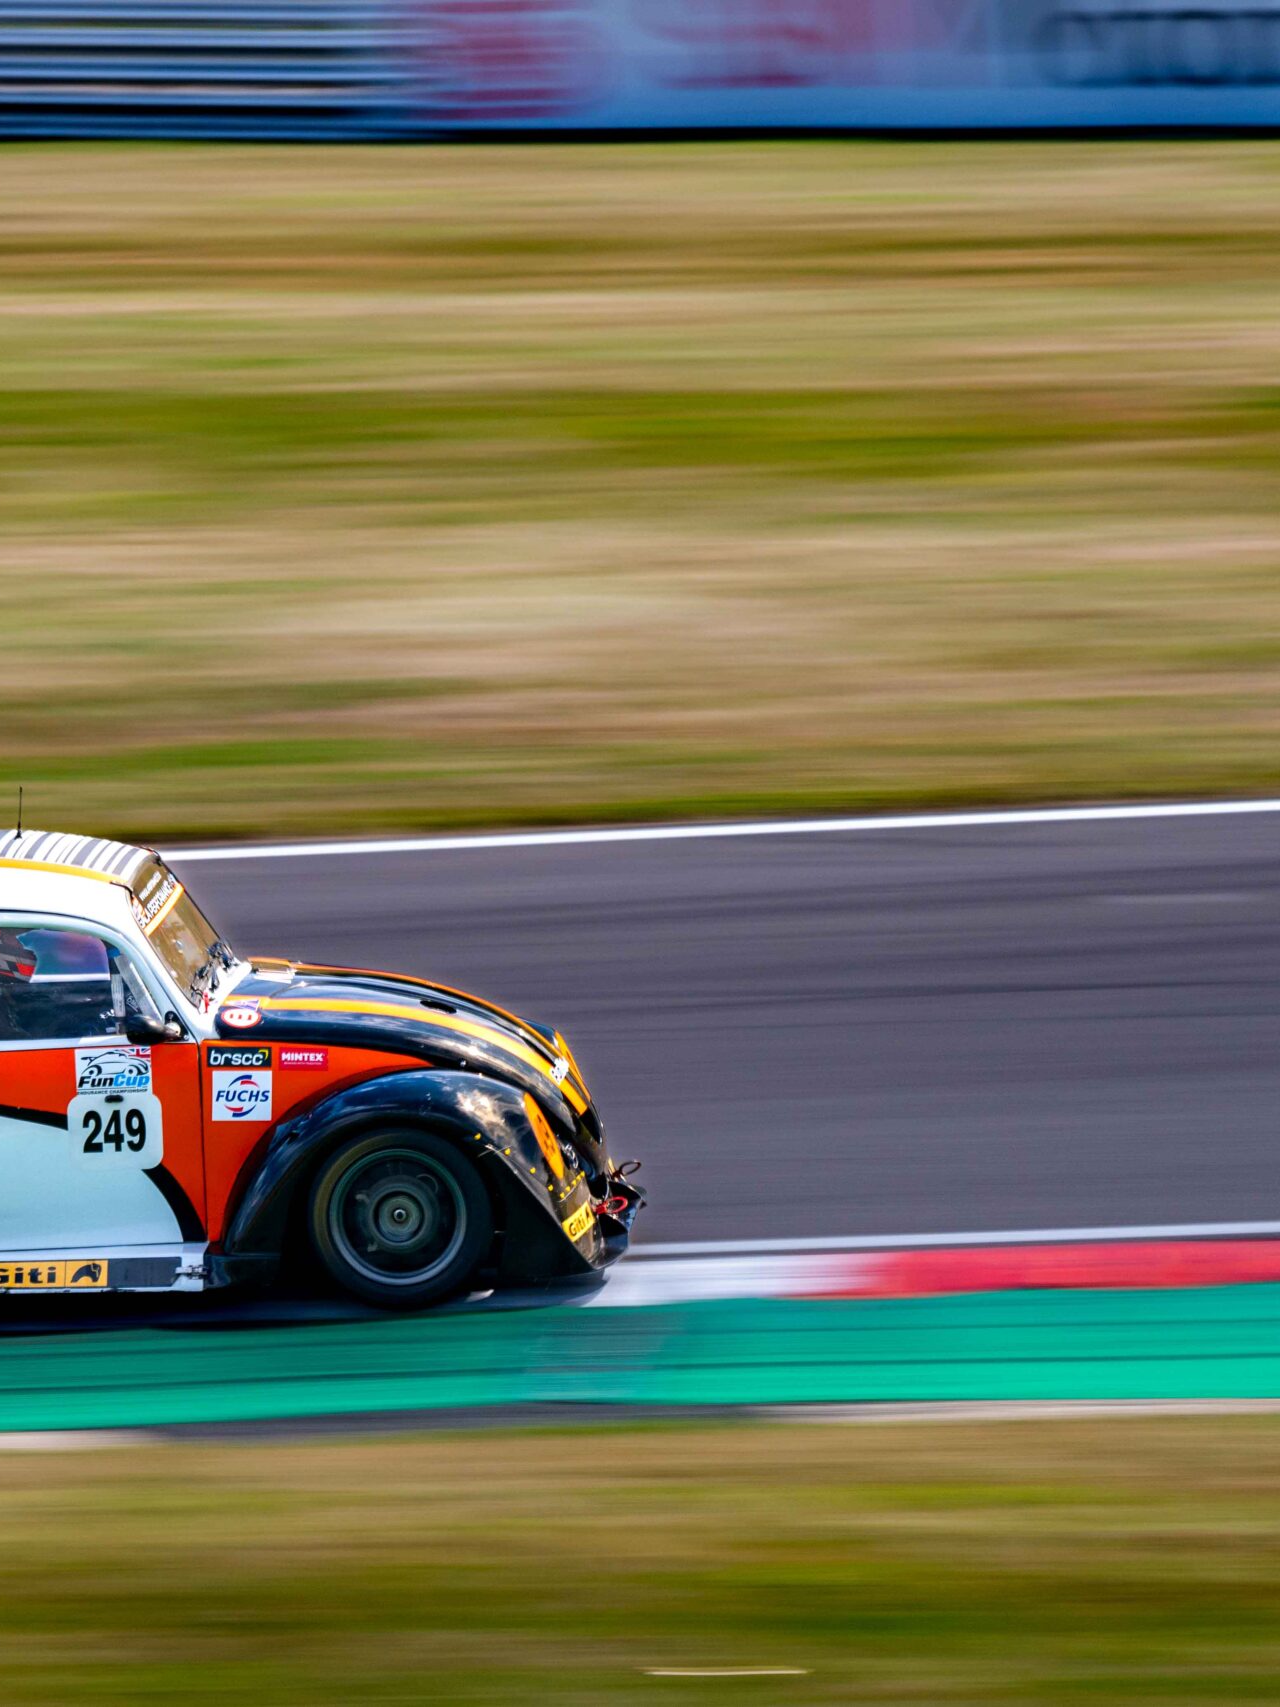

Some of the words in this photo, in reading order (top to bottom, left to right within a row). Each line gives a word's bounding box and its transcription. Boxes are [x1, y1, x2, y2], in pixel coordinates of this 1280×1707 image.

[209, 1049, 264, 1066] brscc
[281, 1052, 324, 1062] MINTEX
[78, 1073, 150, 1088] FunCup
[215, 1090, 270, 1102] FUCHS
[82, 1108, 147, 1154] 249
